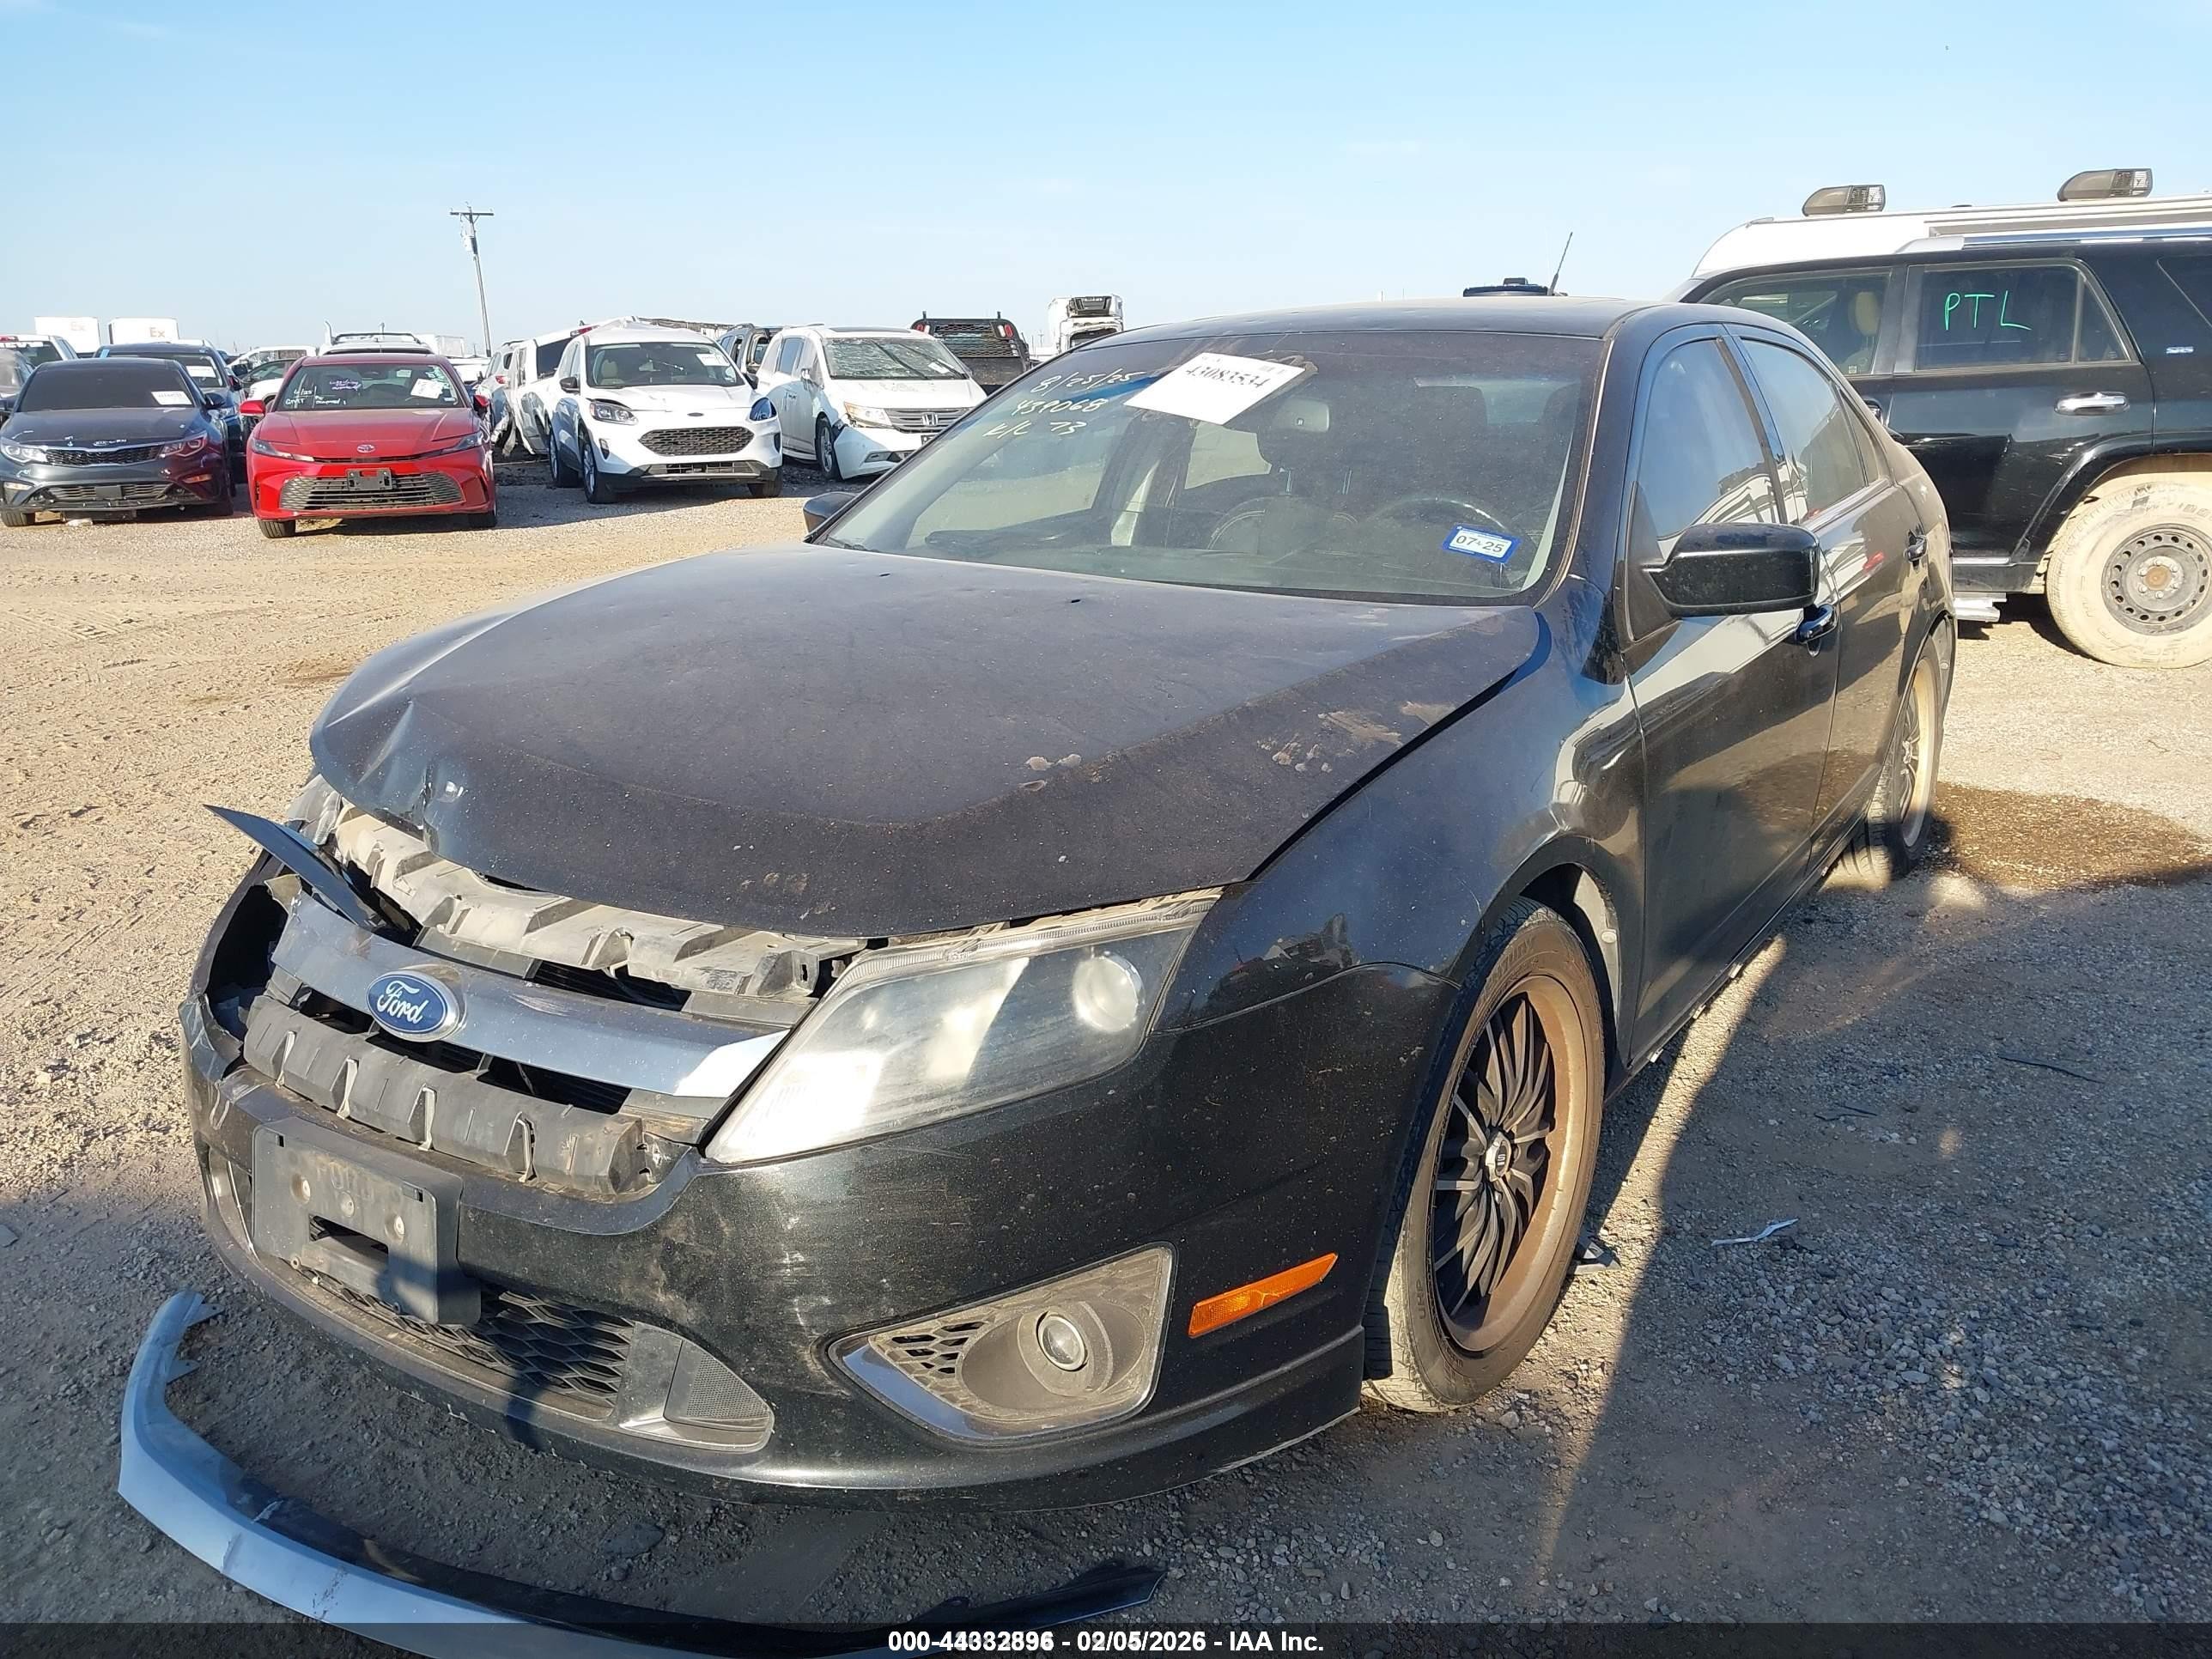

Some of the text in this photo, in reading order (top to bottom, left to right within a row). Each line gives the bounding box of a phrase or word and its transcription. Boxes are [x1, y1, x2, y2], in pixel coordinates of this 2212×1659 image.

[1944, 290, 2032, 331] PTL
[149, 327, 166, 338] Ex
[1030, 368, 1146, 397] 8/25/25
[1455, 535, 1504, 553] 07 25
[376, 980, 429, 1024] Ford
